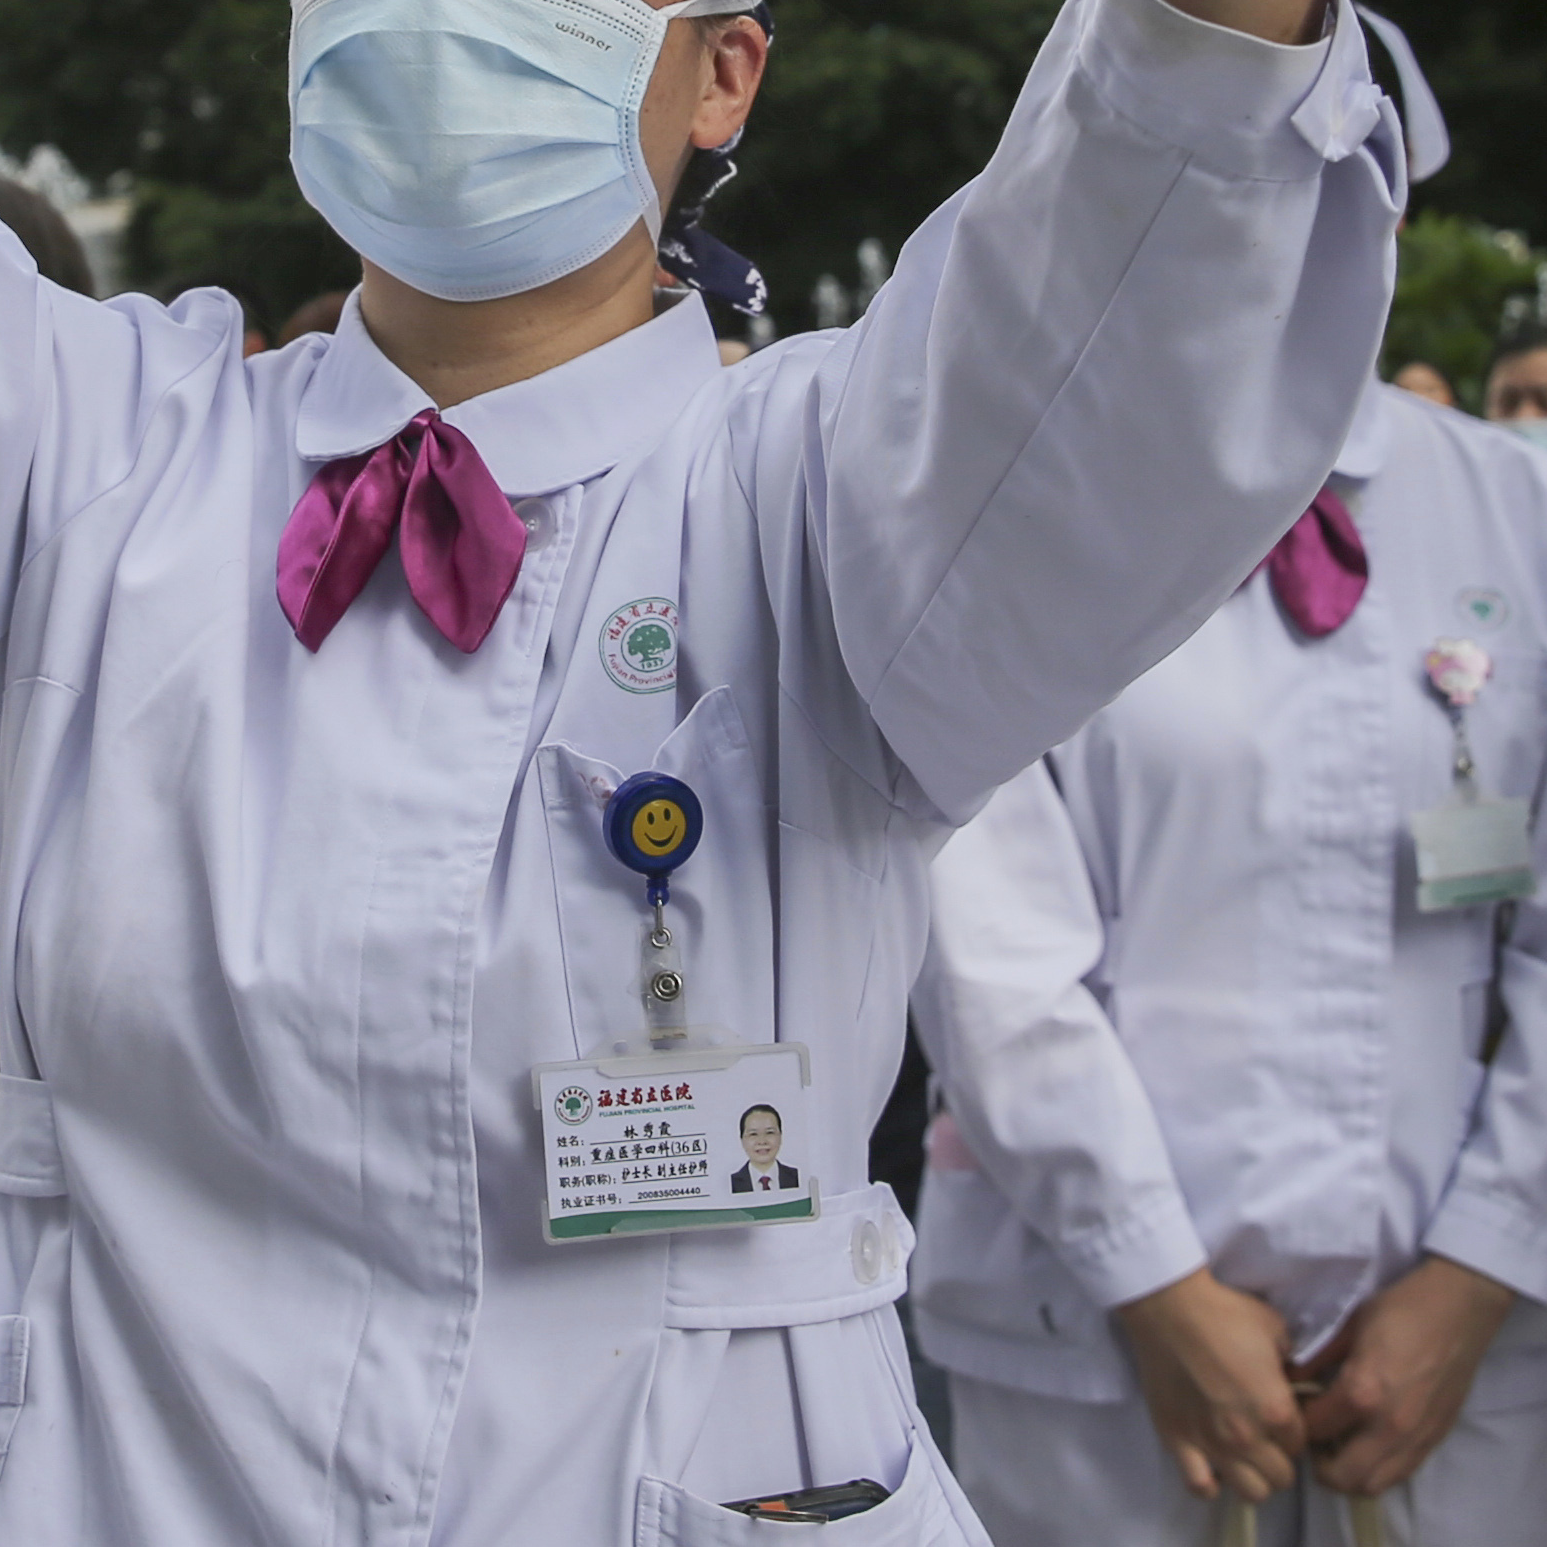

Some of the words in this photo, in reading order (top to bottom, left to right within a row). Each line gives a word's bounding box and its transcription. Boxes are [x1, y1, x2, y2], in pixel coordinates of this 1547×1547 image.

[555, 22, 612, 51] winner
[597, 1082, 693, 1108] 福建省立医院
